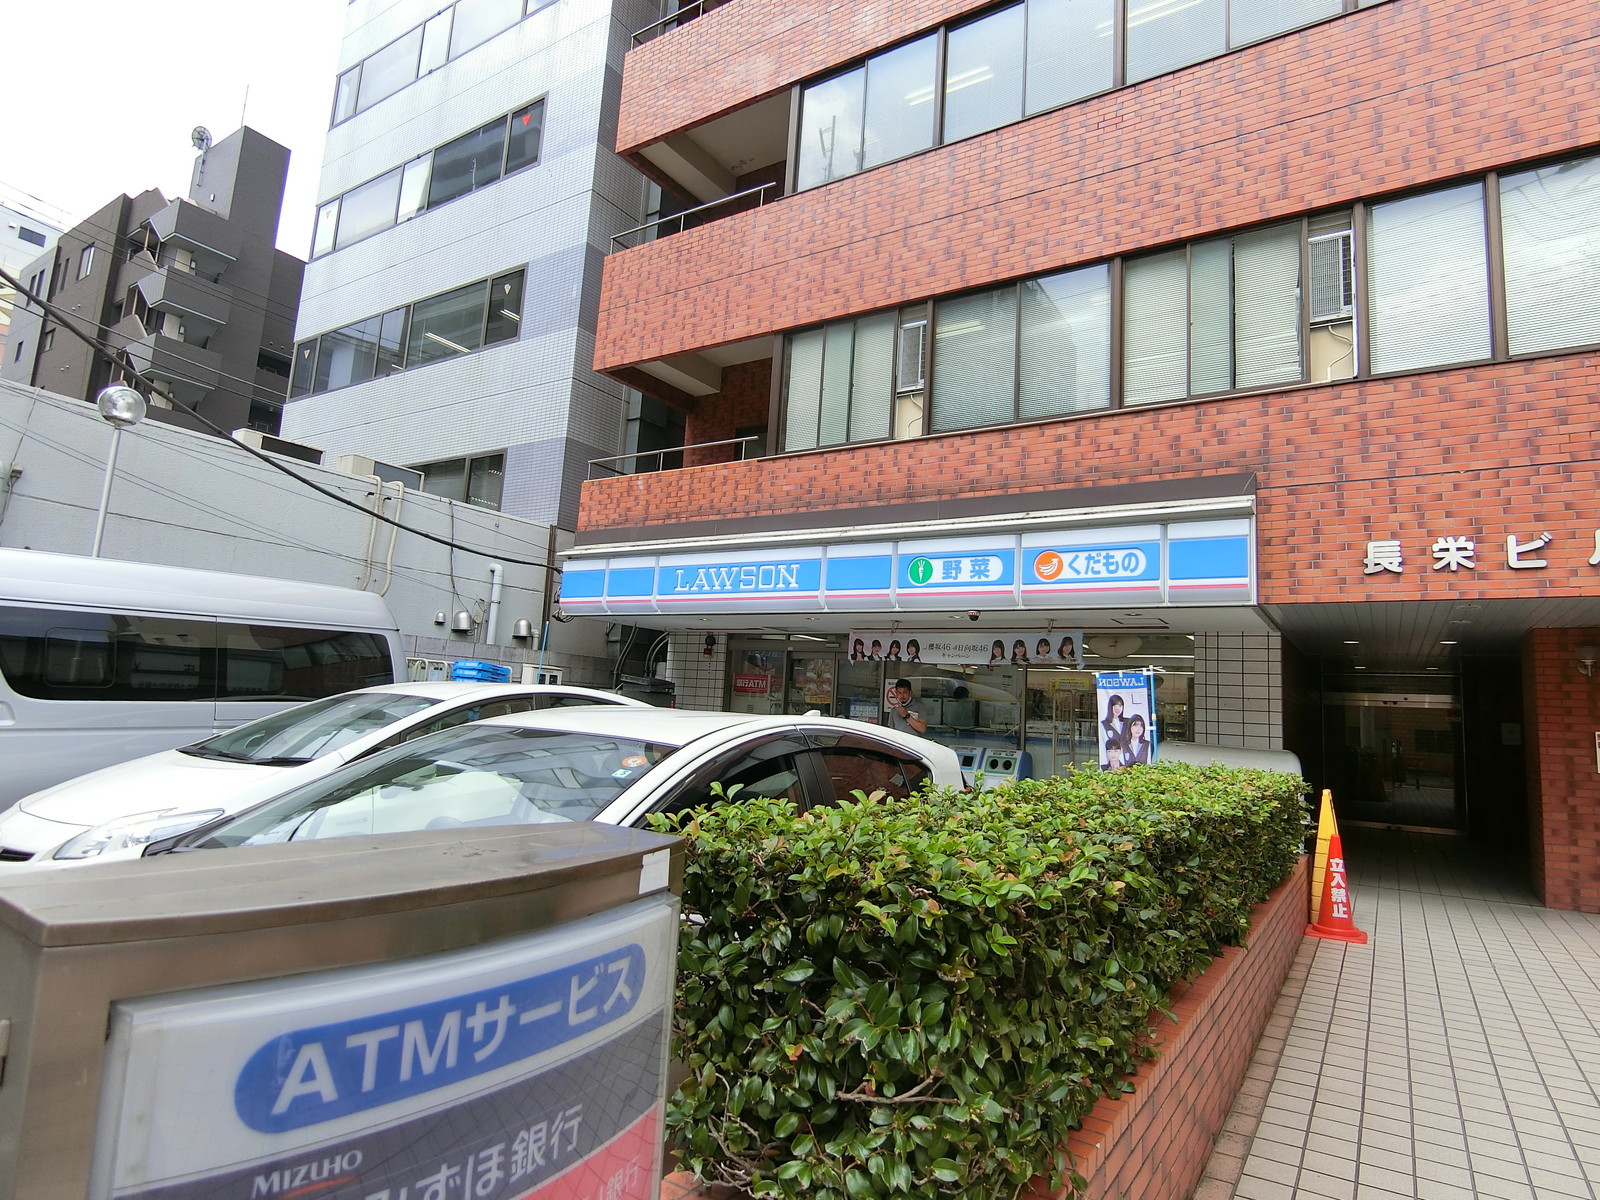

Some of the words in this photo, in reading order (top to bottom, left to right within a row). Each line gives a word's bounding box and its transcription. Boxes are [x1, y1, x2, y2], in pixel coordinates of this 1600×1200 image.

[674, 564, 800, 592] LAWSON
[941, 557, 991, 581] 野菜
[1068, 552, 1140, 576] くだもの
[1329, 858, 1348, 918] 立入禁止
[270, 956, 633, 1116] ATMサービス
[251, 1149, 363, 1200] MIZUHO
[364, 1103, 583, 1200] ずほ銀行
